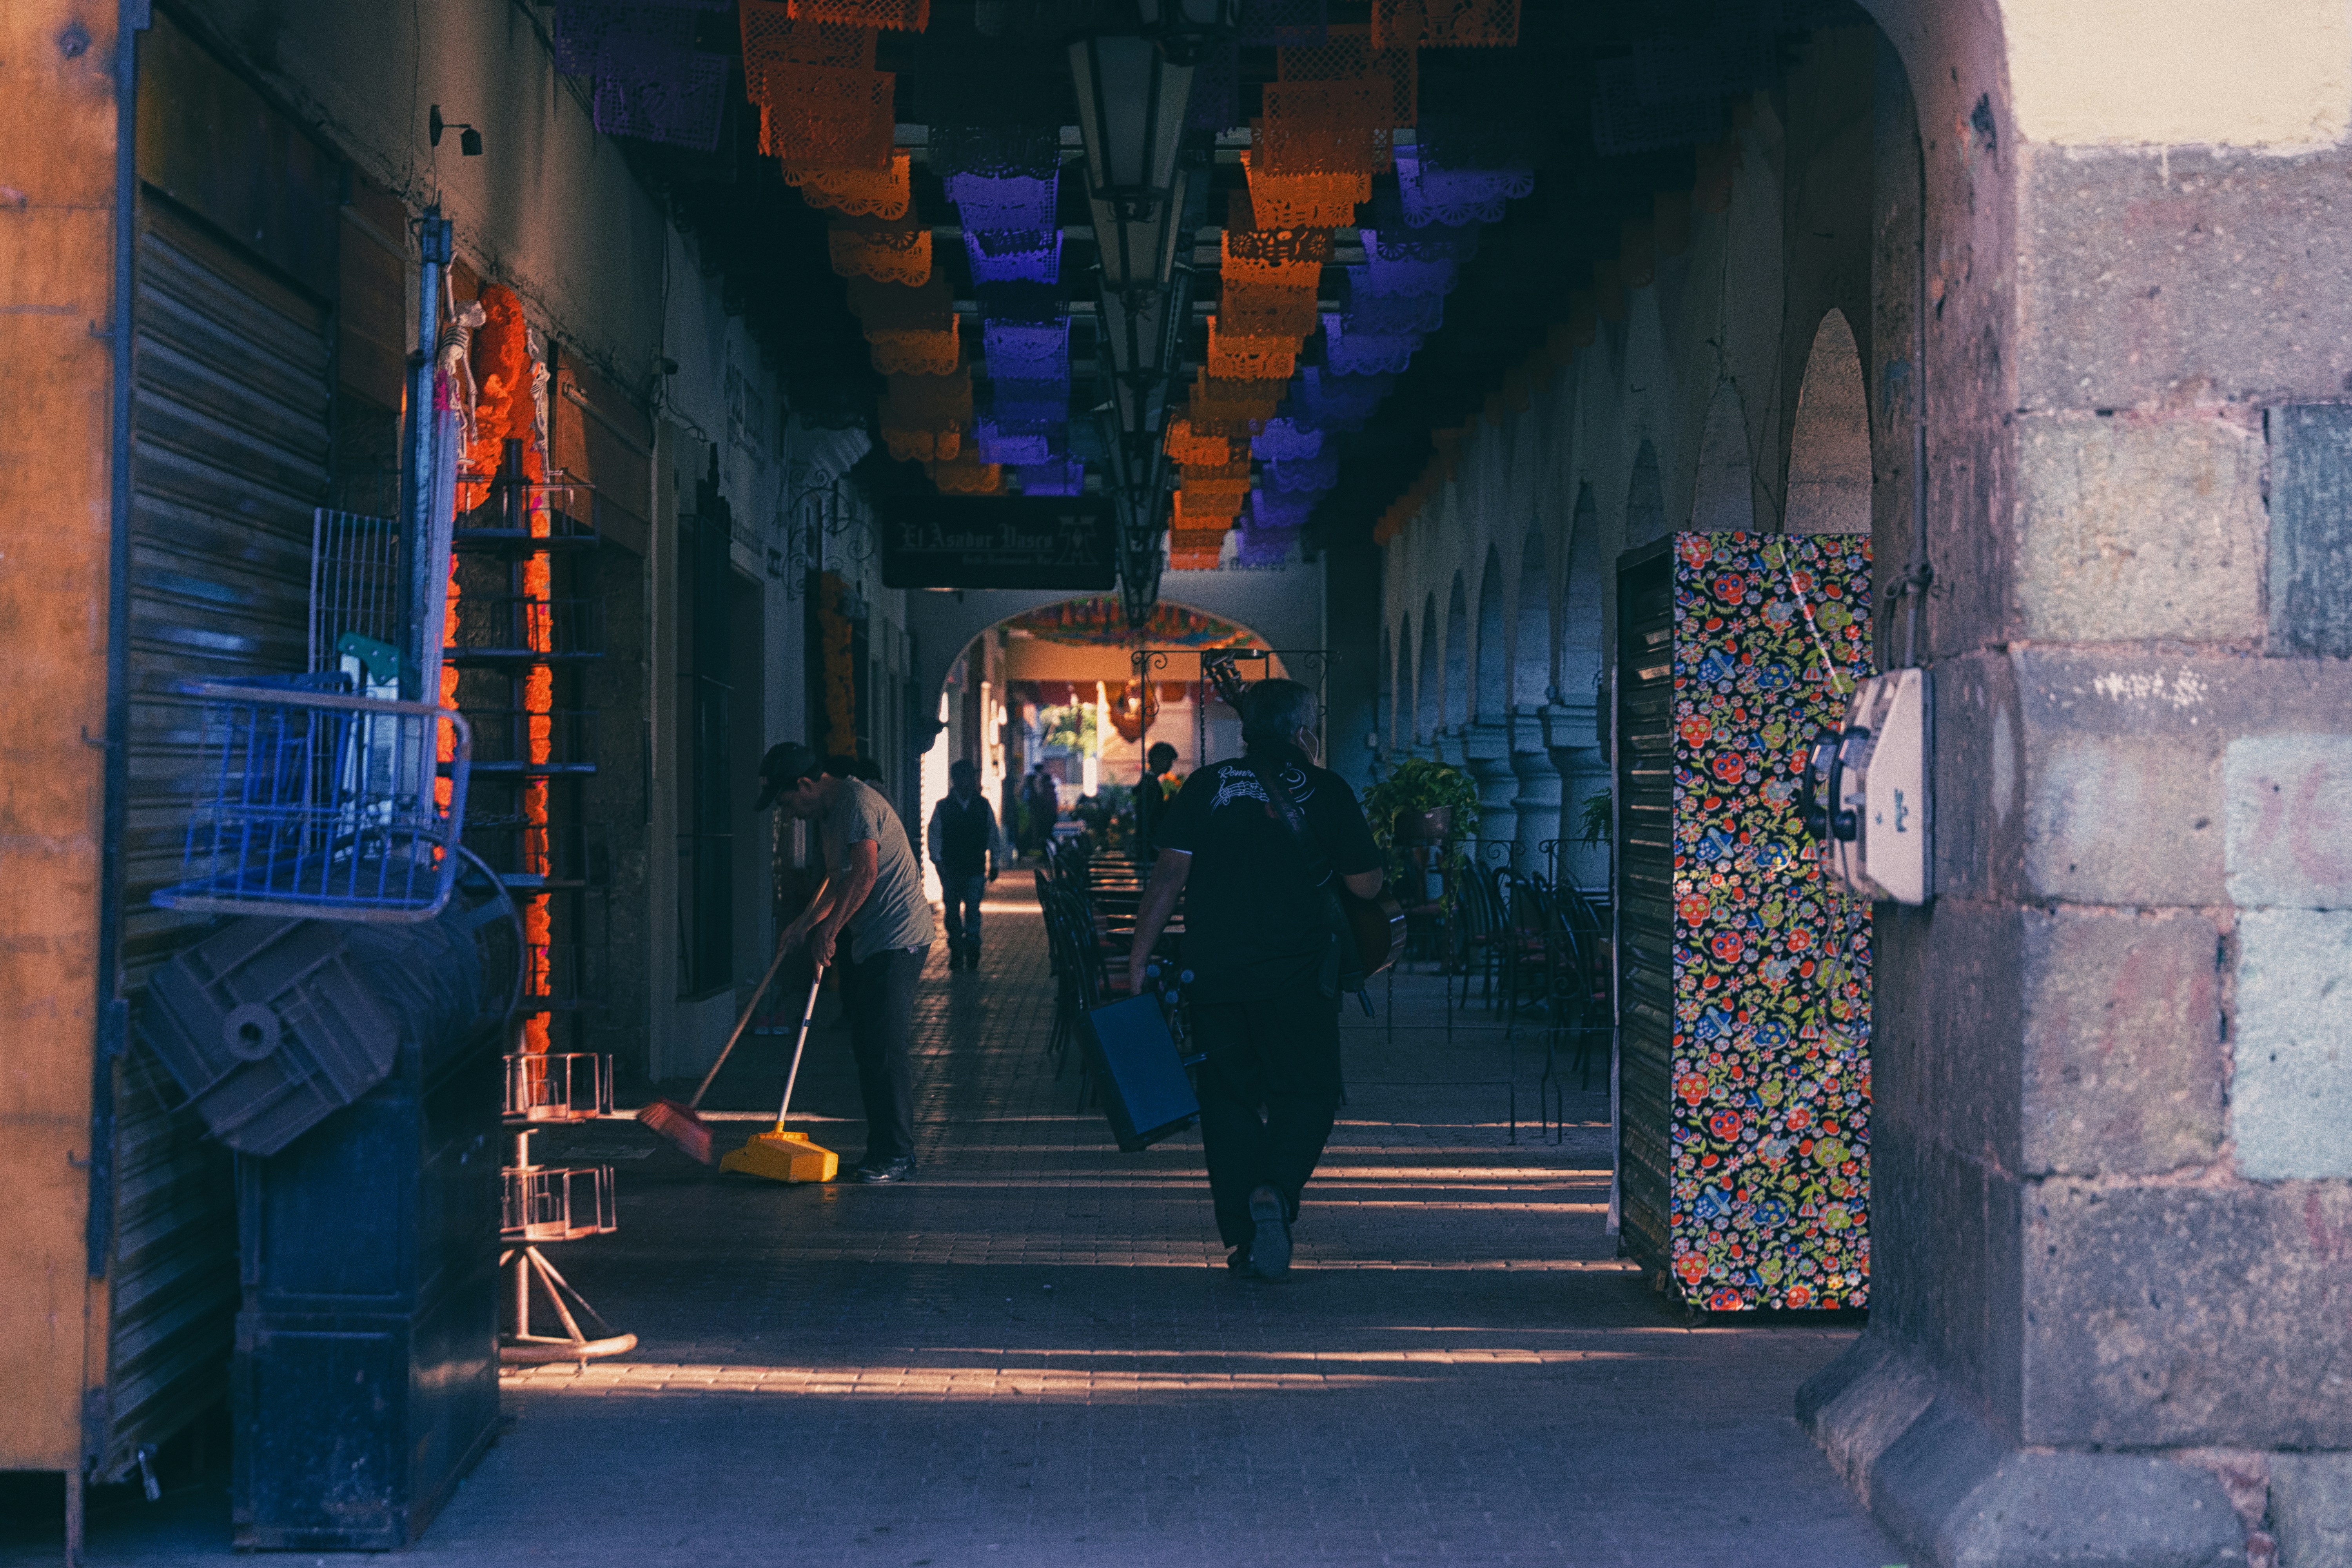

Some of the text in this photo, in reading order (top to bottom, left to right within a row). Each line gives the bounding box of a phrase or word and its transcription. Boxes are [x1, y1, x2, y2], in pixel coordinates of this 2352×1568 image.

[897, 522, 1053, 548] El Asador Vasco
